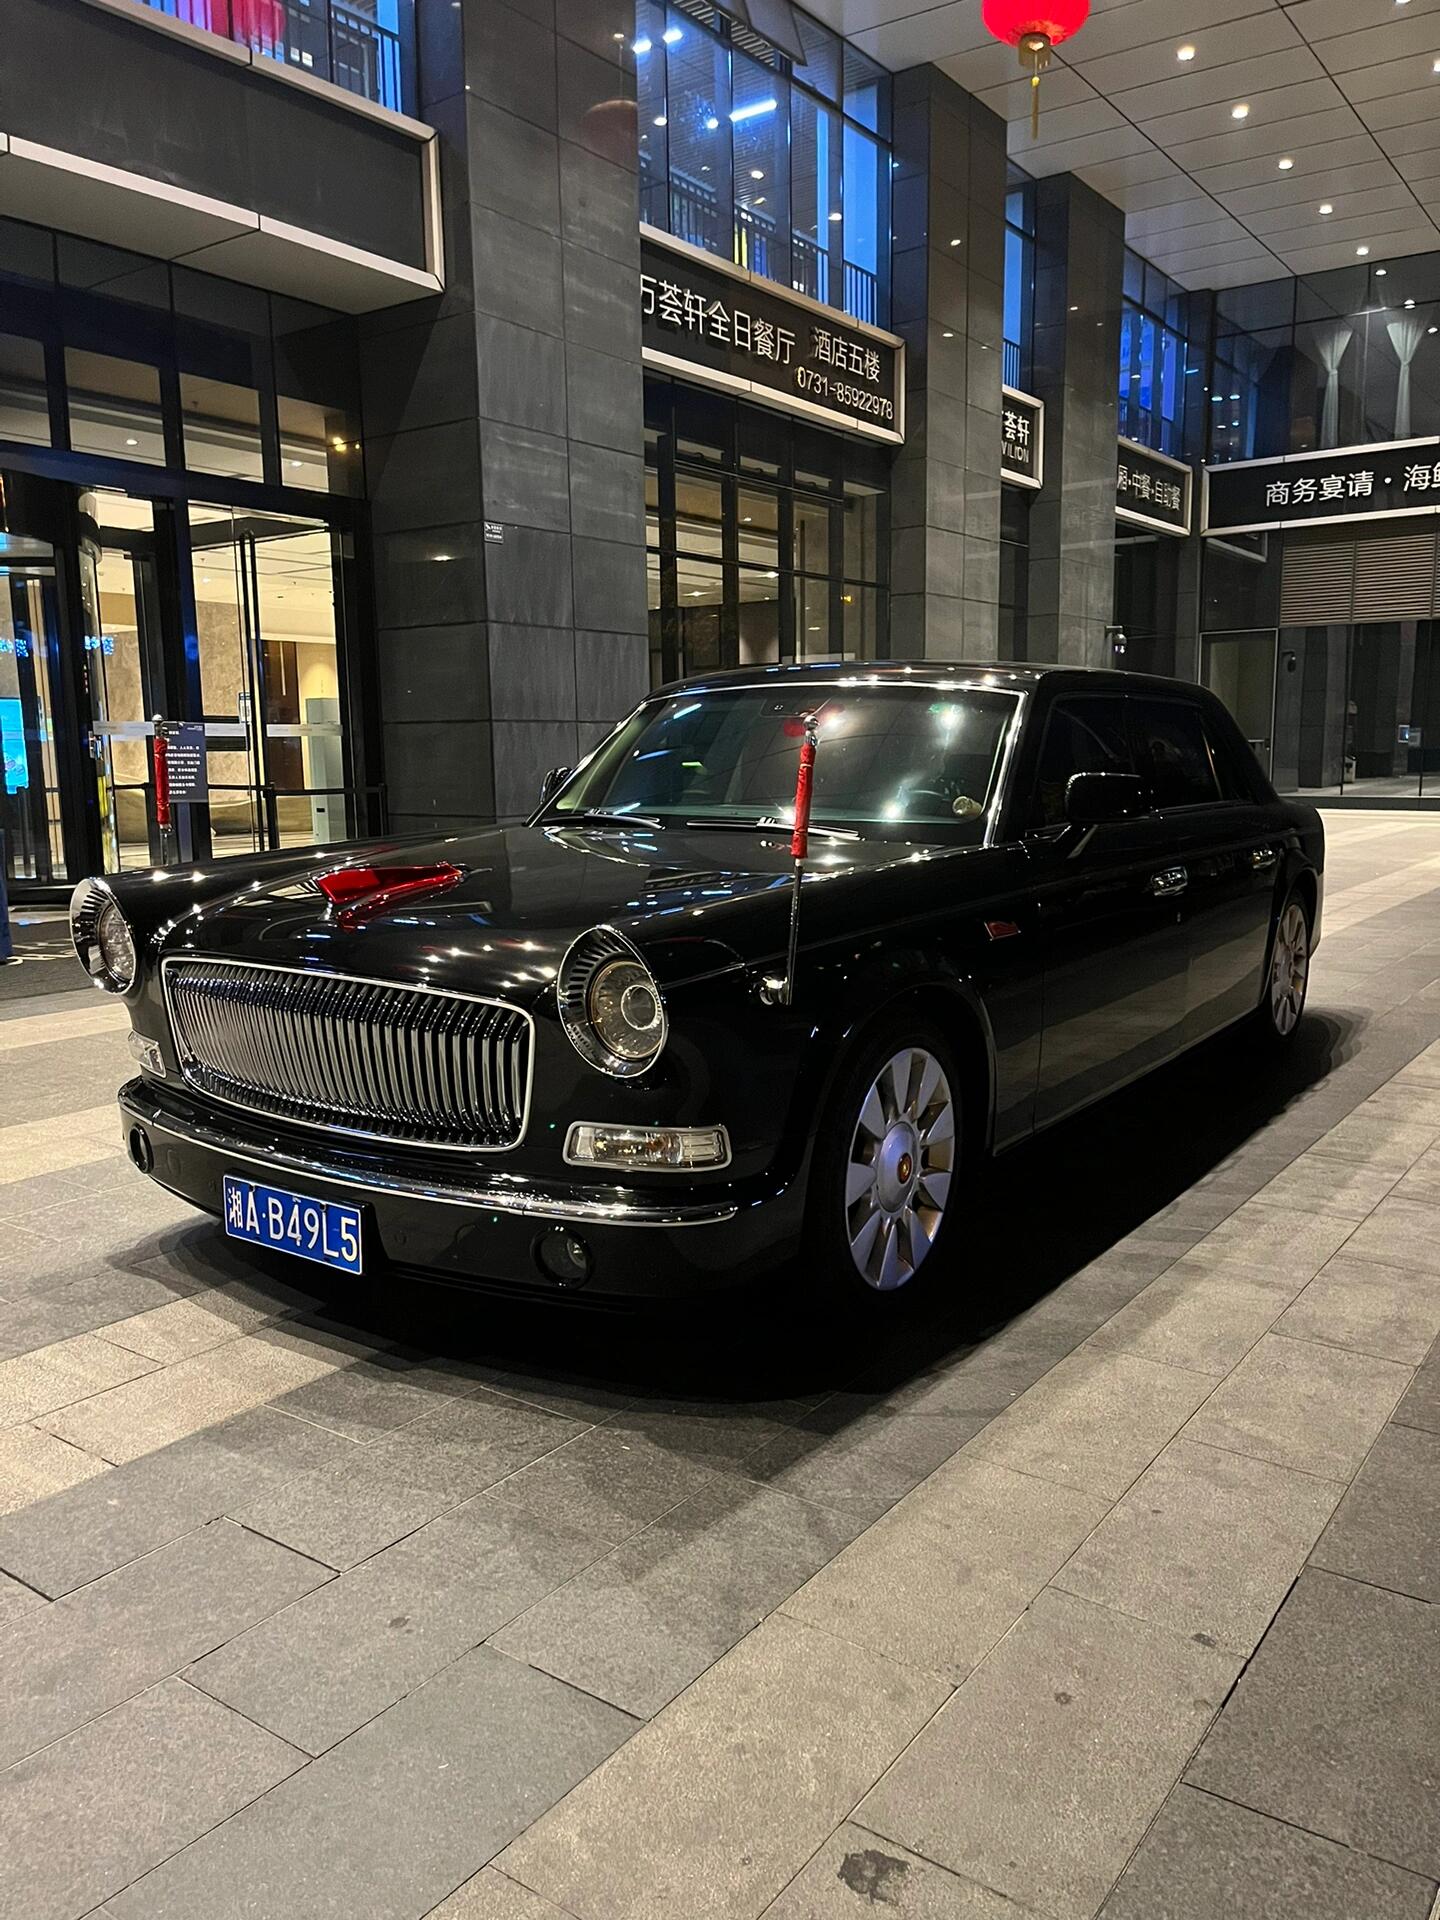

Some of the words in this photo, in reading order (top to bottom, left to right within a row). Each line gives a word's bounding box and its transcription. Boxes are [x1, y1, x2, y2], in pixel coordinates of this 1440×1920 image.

[639, 273, 796, 365] 万荟轩全日餐厅
[813, 325, 881, 383] 酒店五楼
[796, 366, 894, 420] 0731-85922978
[1001, 410, 1030, 446] 荟轩
